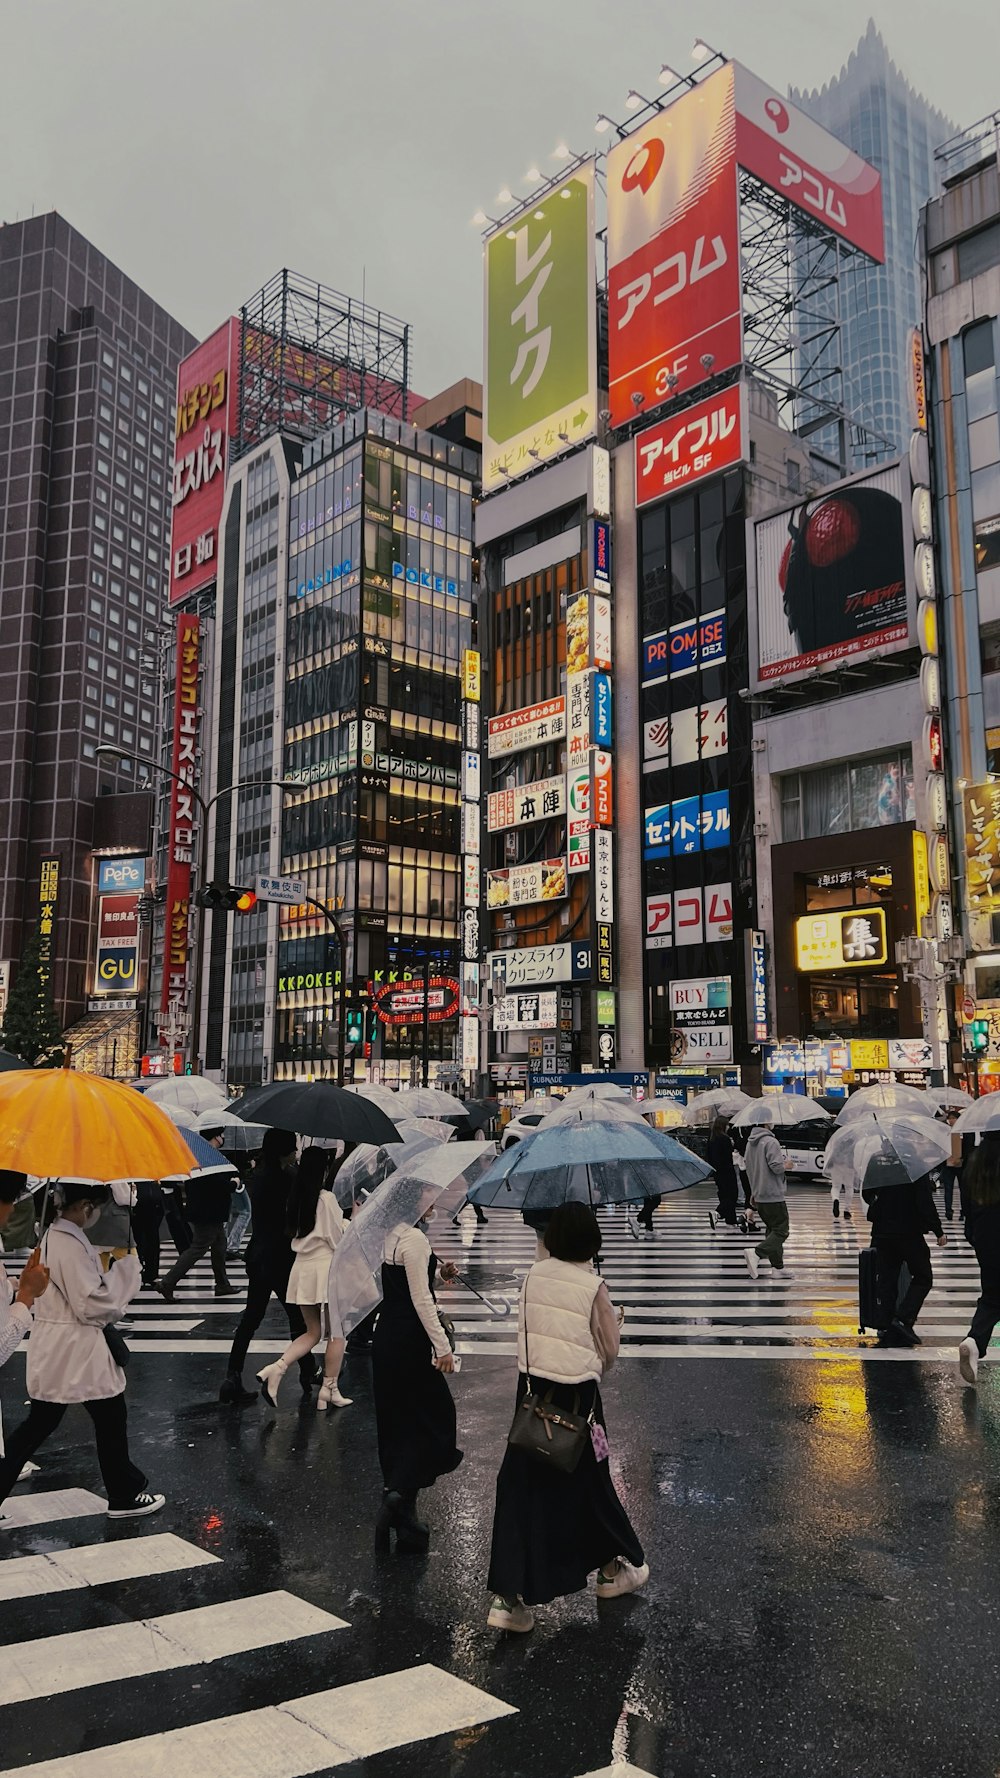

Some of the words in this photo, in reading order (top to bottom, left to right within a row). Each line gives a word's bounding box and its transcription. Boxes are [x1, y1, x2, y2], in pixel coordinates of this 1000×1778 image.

[779, 152, 847, 228] アコム
[617, 235, 728, 331] アコム
[510, 225, 554, 399] レイク
[655, 354, 689, 397] 3F
[176, 368, 227, 439] パチンコ
[640, 407, 736, 477] アイフル
[172, 425, 223, 507] エスパス
[664, 464, 692, 485] 当ビル
[299, 497, 352, 537] SHISHA
[407, 505, 445, 529] BAR
[174, 527, 214, 579] 日拓
[598, 526, 606, 569] PROMISE
[297, 559, 353, 599] CASINO
[392, 560, 459, 598] POKER
[648, 620, 724, 664] PROMISE
[181, 627, 198, 704] パチンコ
[598, 682, 607, 738] セントラル
[175, 709, 195, 821] エスパス
[521, 789, 560, 820] 本陣
[598, 779, 608, 812] アコム
[599, 813, 608, 822] 3F
[646, 808, 731, 845] セントラル
[684, 842, 695, 852] 4F
[970, 798, 994, 898] レモンサワー
[104, 866, 139, 882] PePe
[260, 879, 302, 894] 歌舞伎町
[513, 875, 537, 889] 粉もの
[268, 891, 295, 900] Kabukicho
[513, 887, 537, 901] 専門店
[40, 904, 53, 934] 水着
[104, 912, 135, 922] 無印良品
[648, 894, 733, 933] アコム
[117, 938, 135, 946] FREE
[169, 899, 189, 965] パチンコ
[654, 937, 666, 947] 3F
[843, 918, 879, 959] 集
[100, 958, 134, 980] GU
[509, 946, 565, 966] メンズライフ
[600, 955, 610, 980] 販売
[279, 970, 342, 992] KKPOKER
[509, 966, 555, 984] クリニック
[92, 1001, 132, 1010] 西武新宿駅
[675, 988, 705, 1004] BUY
[689, 1031, 728, 1048] SELL
[871, 1044, 886, 1065] 集
[532, 1076, 562, 1084] SUBNADE
[655, 1088, 683, 1097] SUBNADE
